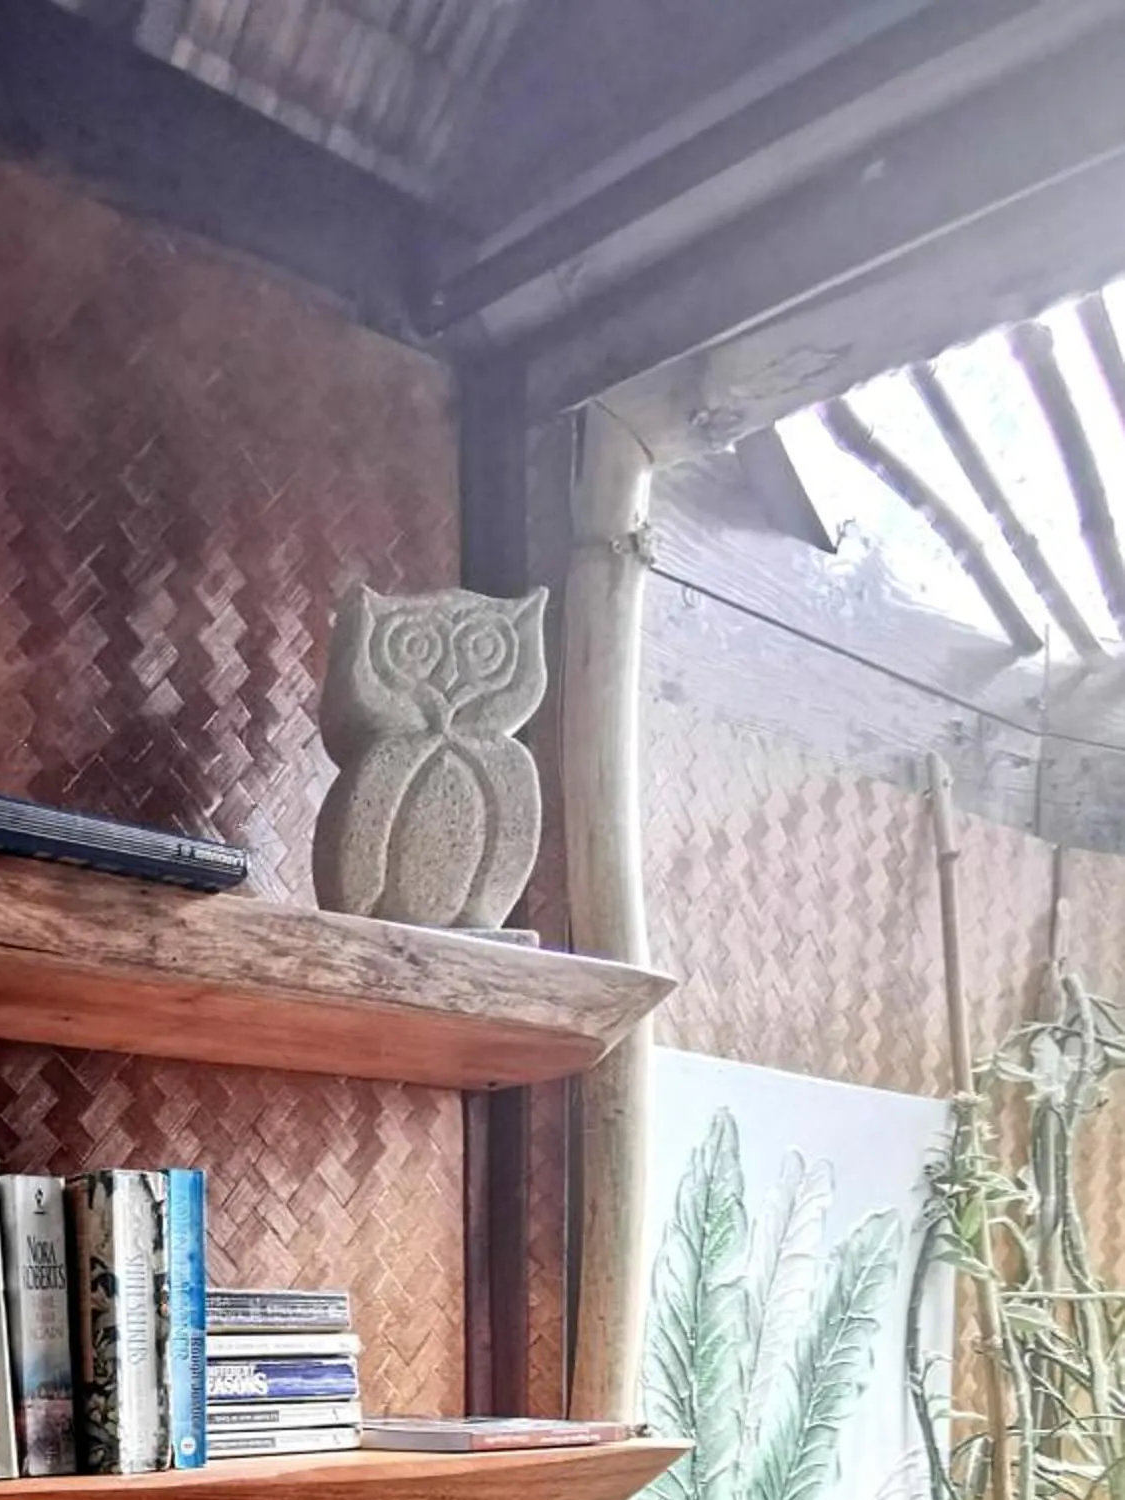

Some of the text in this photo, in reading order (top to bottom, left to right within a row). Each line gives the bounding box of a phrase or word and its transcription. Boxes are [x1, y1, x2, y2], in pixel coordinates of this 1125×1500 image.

[27, 1236, 57, 1263] NORA
[22, 1264, 66, 1291] ROBERTS
[189, 1336, 203, 1378] Rough
